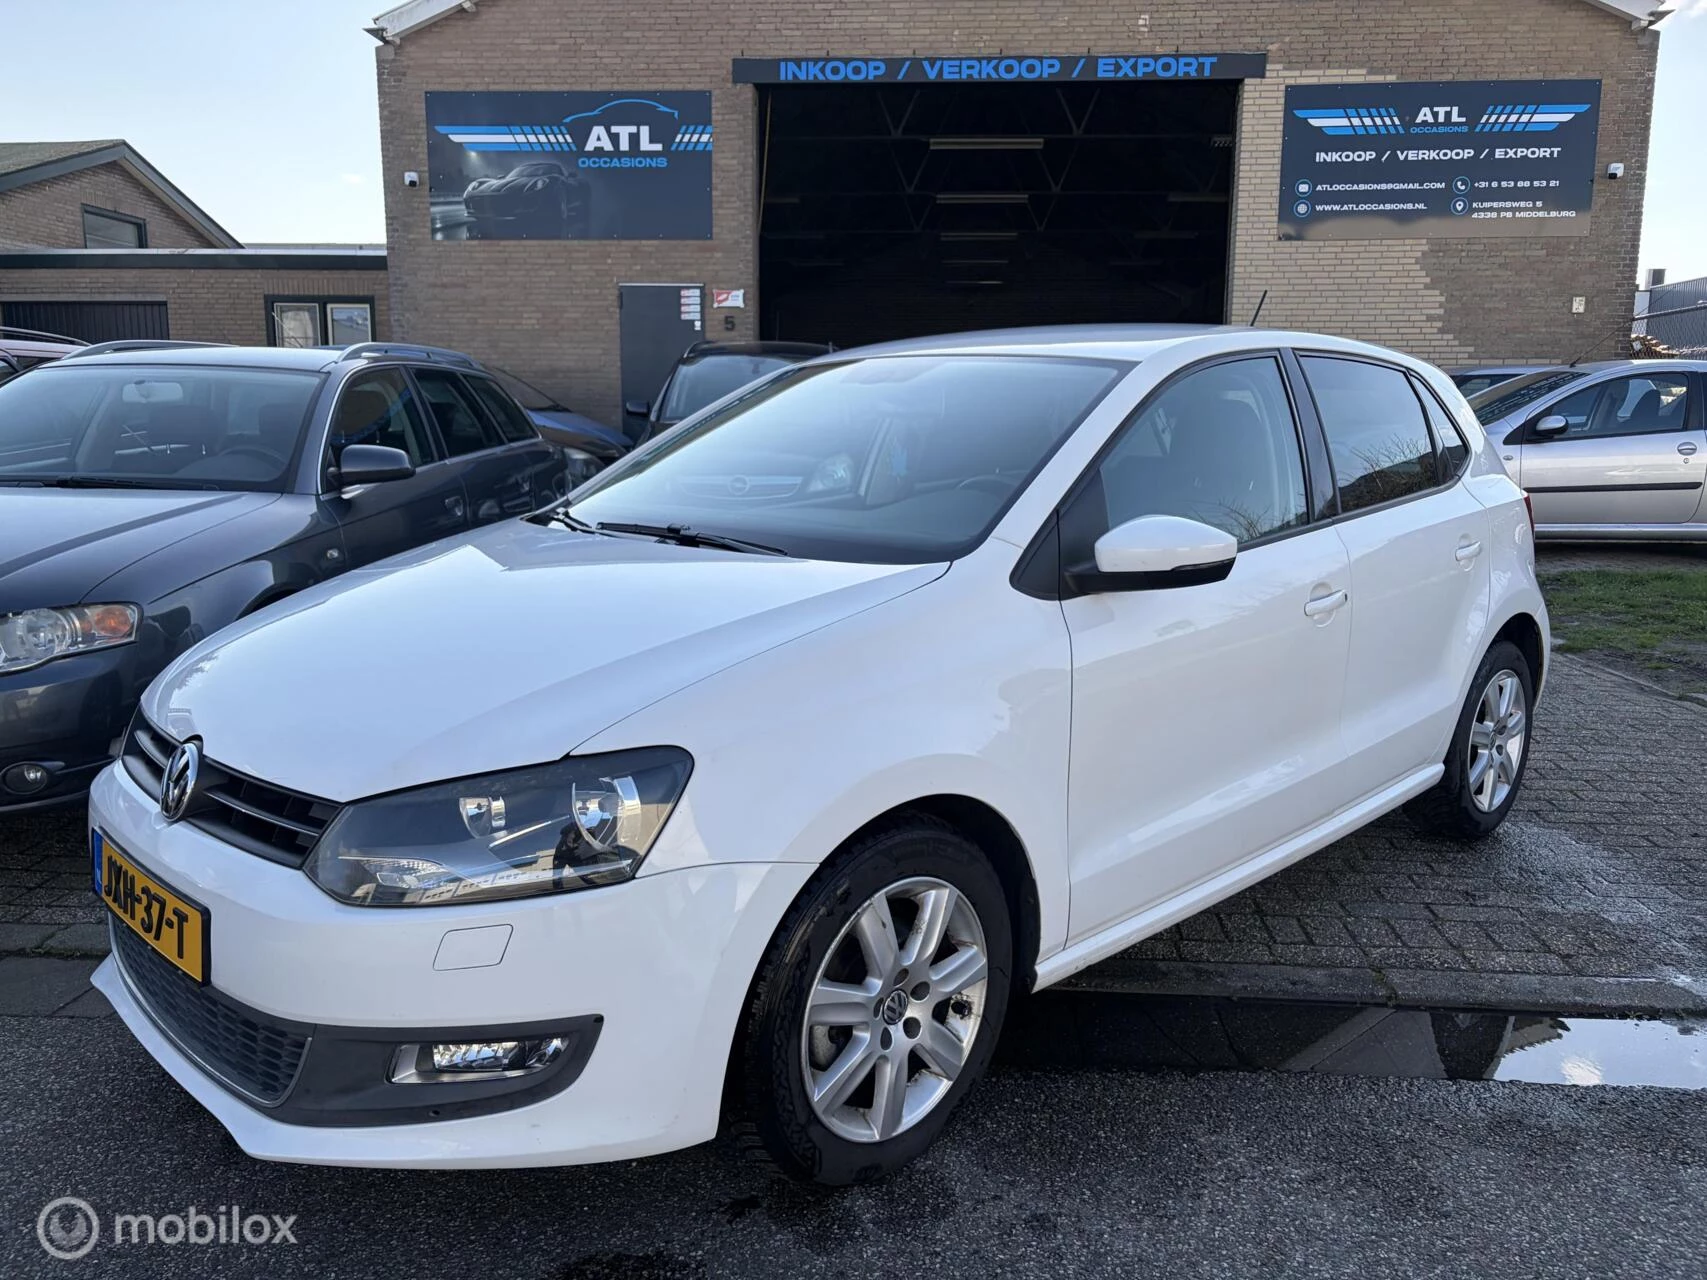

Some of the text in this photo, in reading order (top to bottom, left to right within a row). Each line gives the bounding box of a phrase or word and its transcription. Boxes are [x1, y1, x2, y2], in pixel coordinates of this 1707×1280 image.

[779, 55, 1217, 82] INKOOP / VERKOOP / EXPORT
[1415, 106, 1467, 124] ATL
[1410, 125, 1469, 134] OCCASIONS
[584, 125, 663, 152] ATL
[578, 157, 668, 168] OCCASIONS
[1315, 147, 1562, 163] INKOOP / VERKOOP / EXPORT
[1316, 182, 1446, 191] ATLOCCASIONS@GMAIL.COM
[1315, 203, 1427, 211] WWW.ATLOCCASIONS.NL
[724, 315, 736, 331] 5
[104, 854, 188, 959] JXH-37-T
